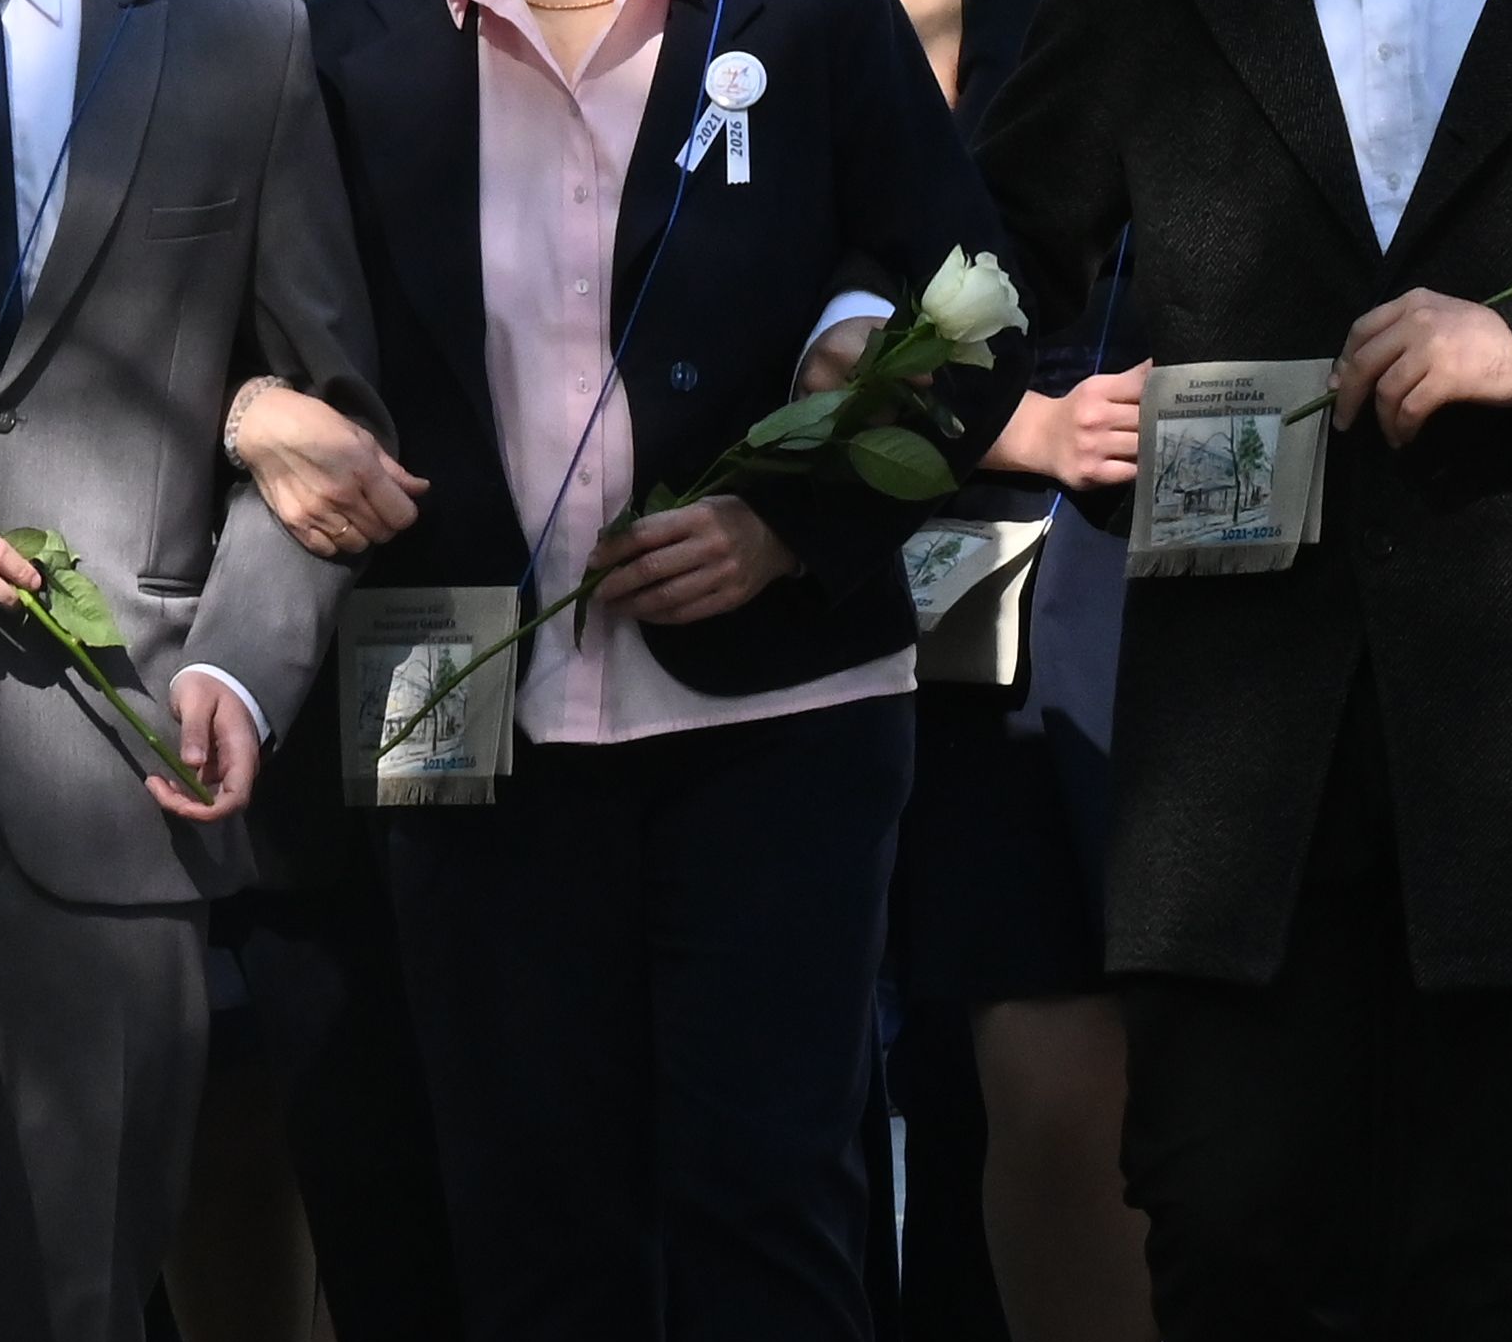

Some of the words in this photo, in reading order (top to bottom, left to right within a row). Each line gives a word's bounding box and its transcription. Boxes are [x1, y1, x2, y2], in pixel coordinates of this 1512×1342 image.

[696, 113, 722, 146] 2021
[730, 121, 742, 157] 2026
[1221, 526, 1282, 541] 2021-2026
[422, 755, 477, 771] 2021-2026
